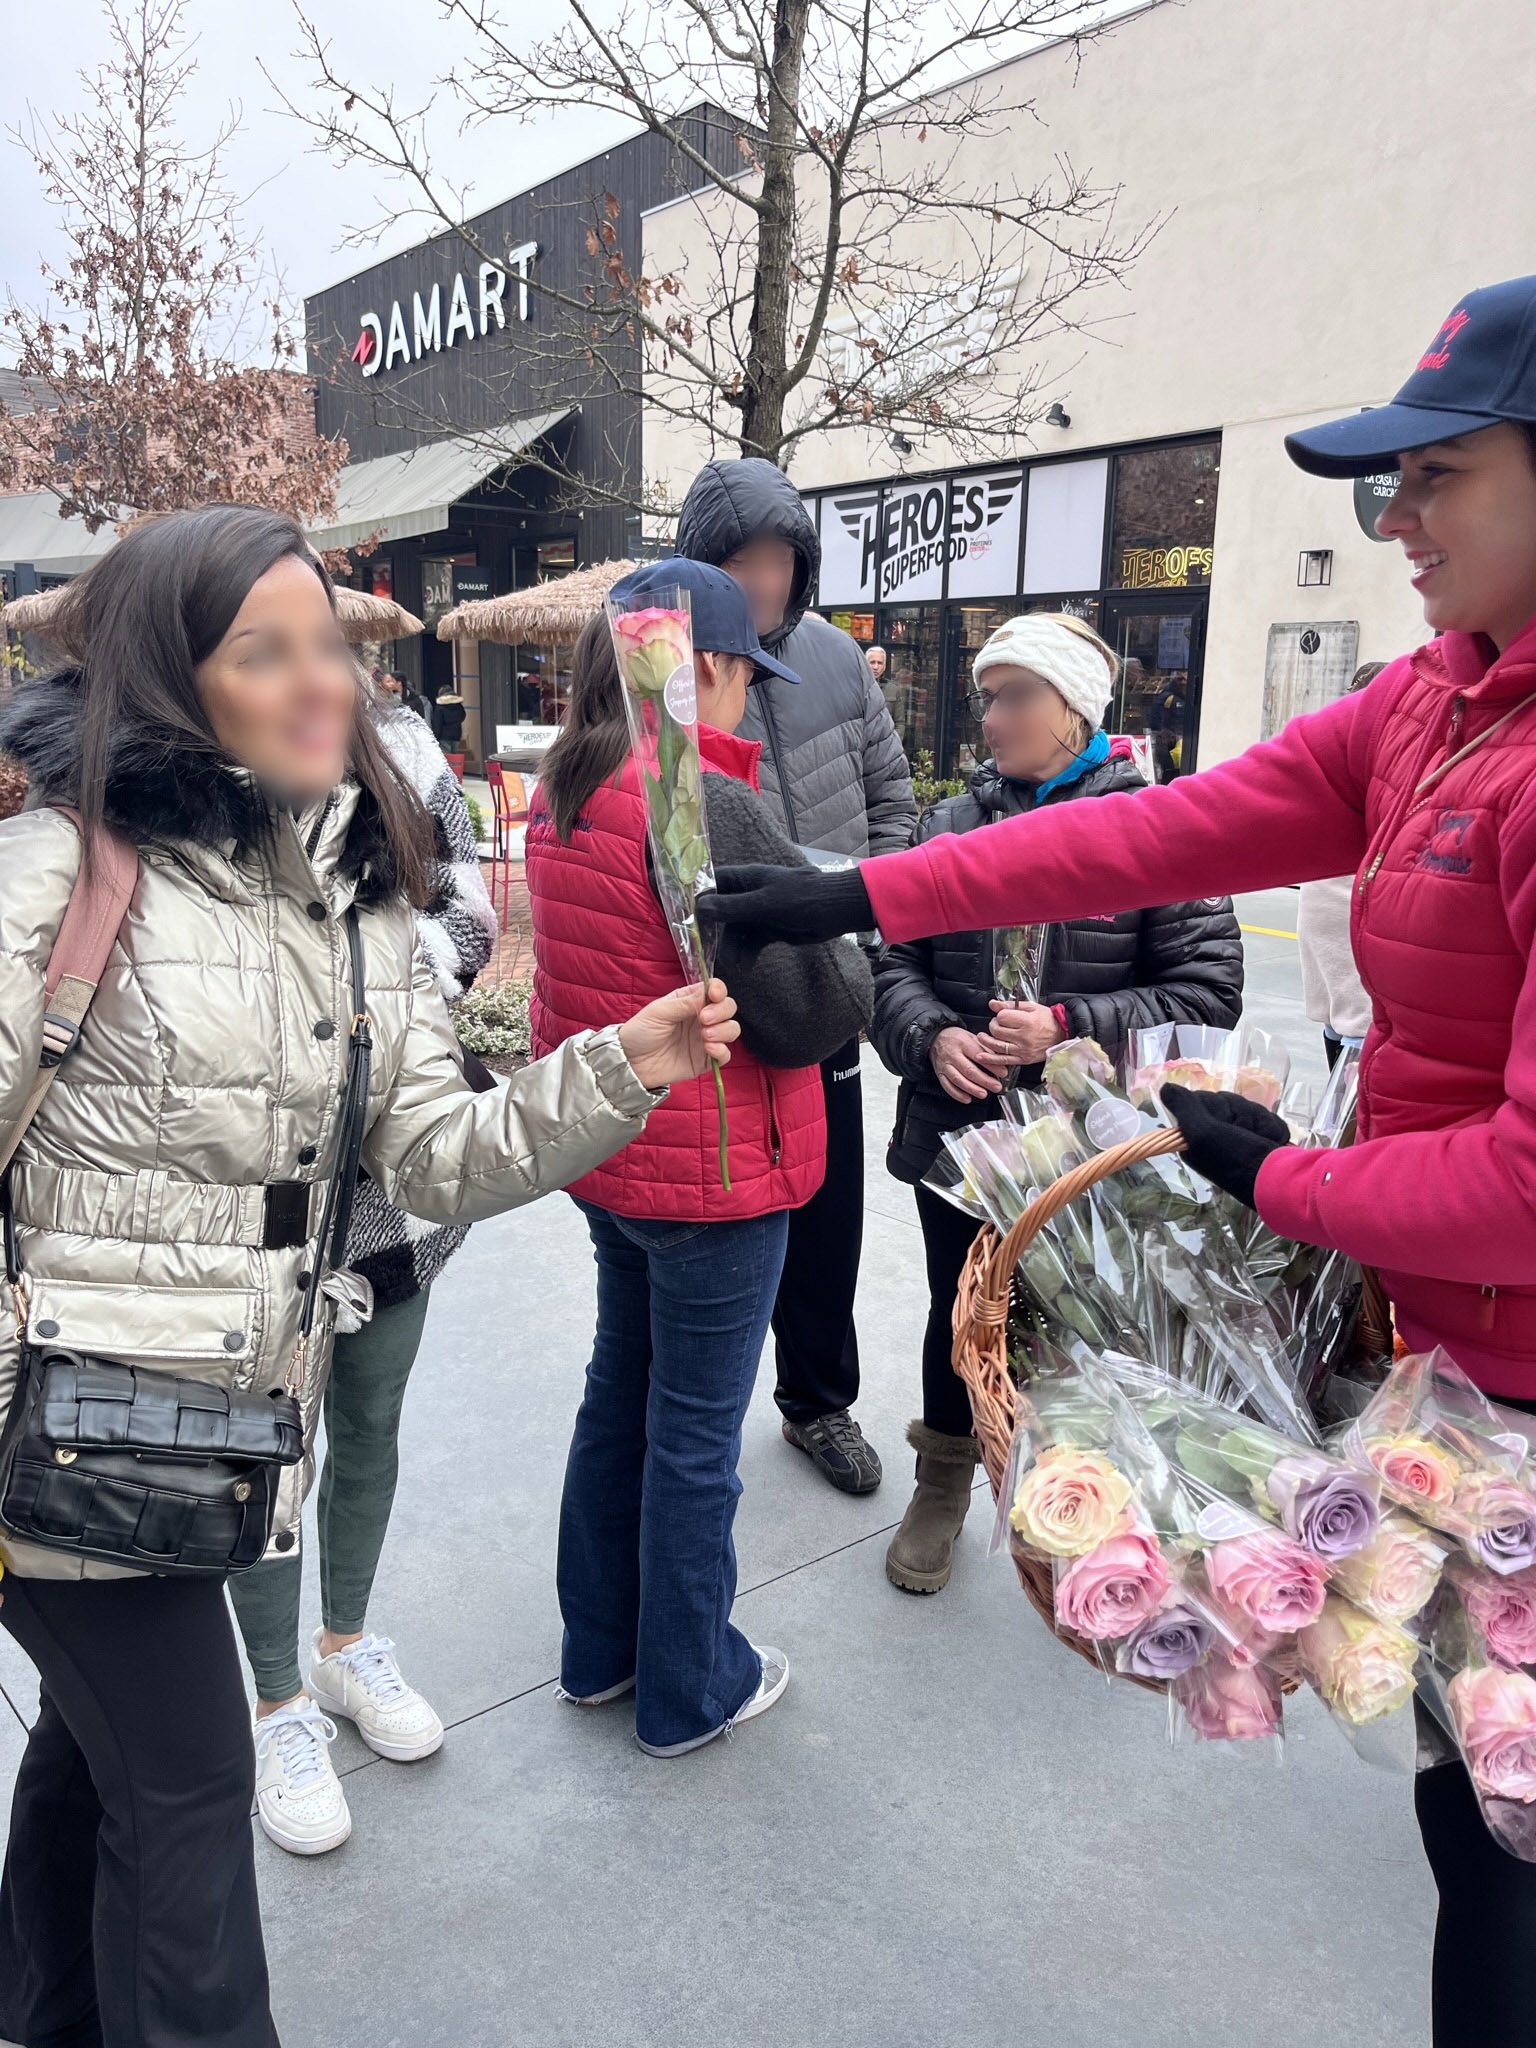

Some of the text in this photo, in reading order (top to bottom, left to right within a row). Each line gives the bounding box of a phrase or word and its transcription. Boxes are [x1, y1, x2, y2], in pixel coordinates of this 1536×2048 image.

[353, 241, 539, 377] DAMART
[1372, 486, 1398, 498] CARCA
[1375, 475, 1393, 487] CASA
[860, 486, 984, 590] HEROES
[882, 536, 968, 598] SUPERFOOD
[457, 582, 489, 592] DAMART
